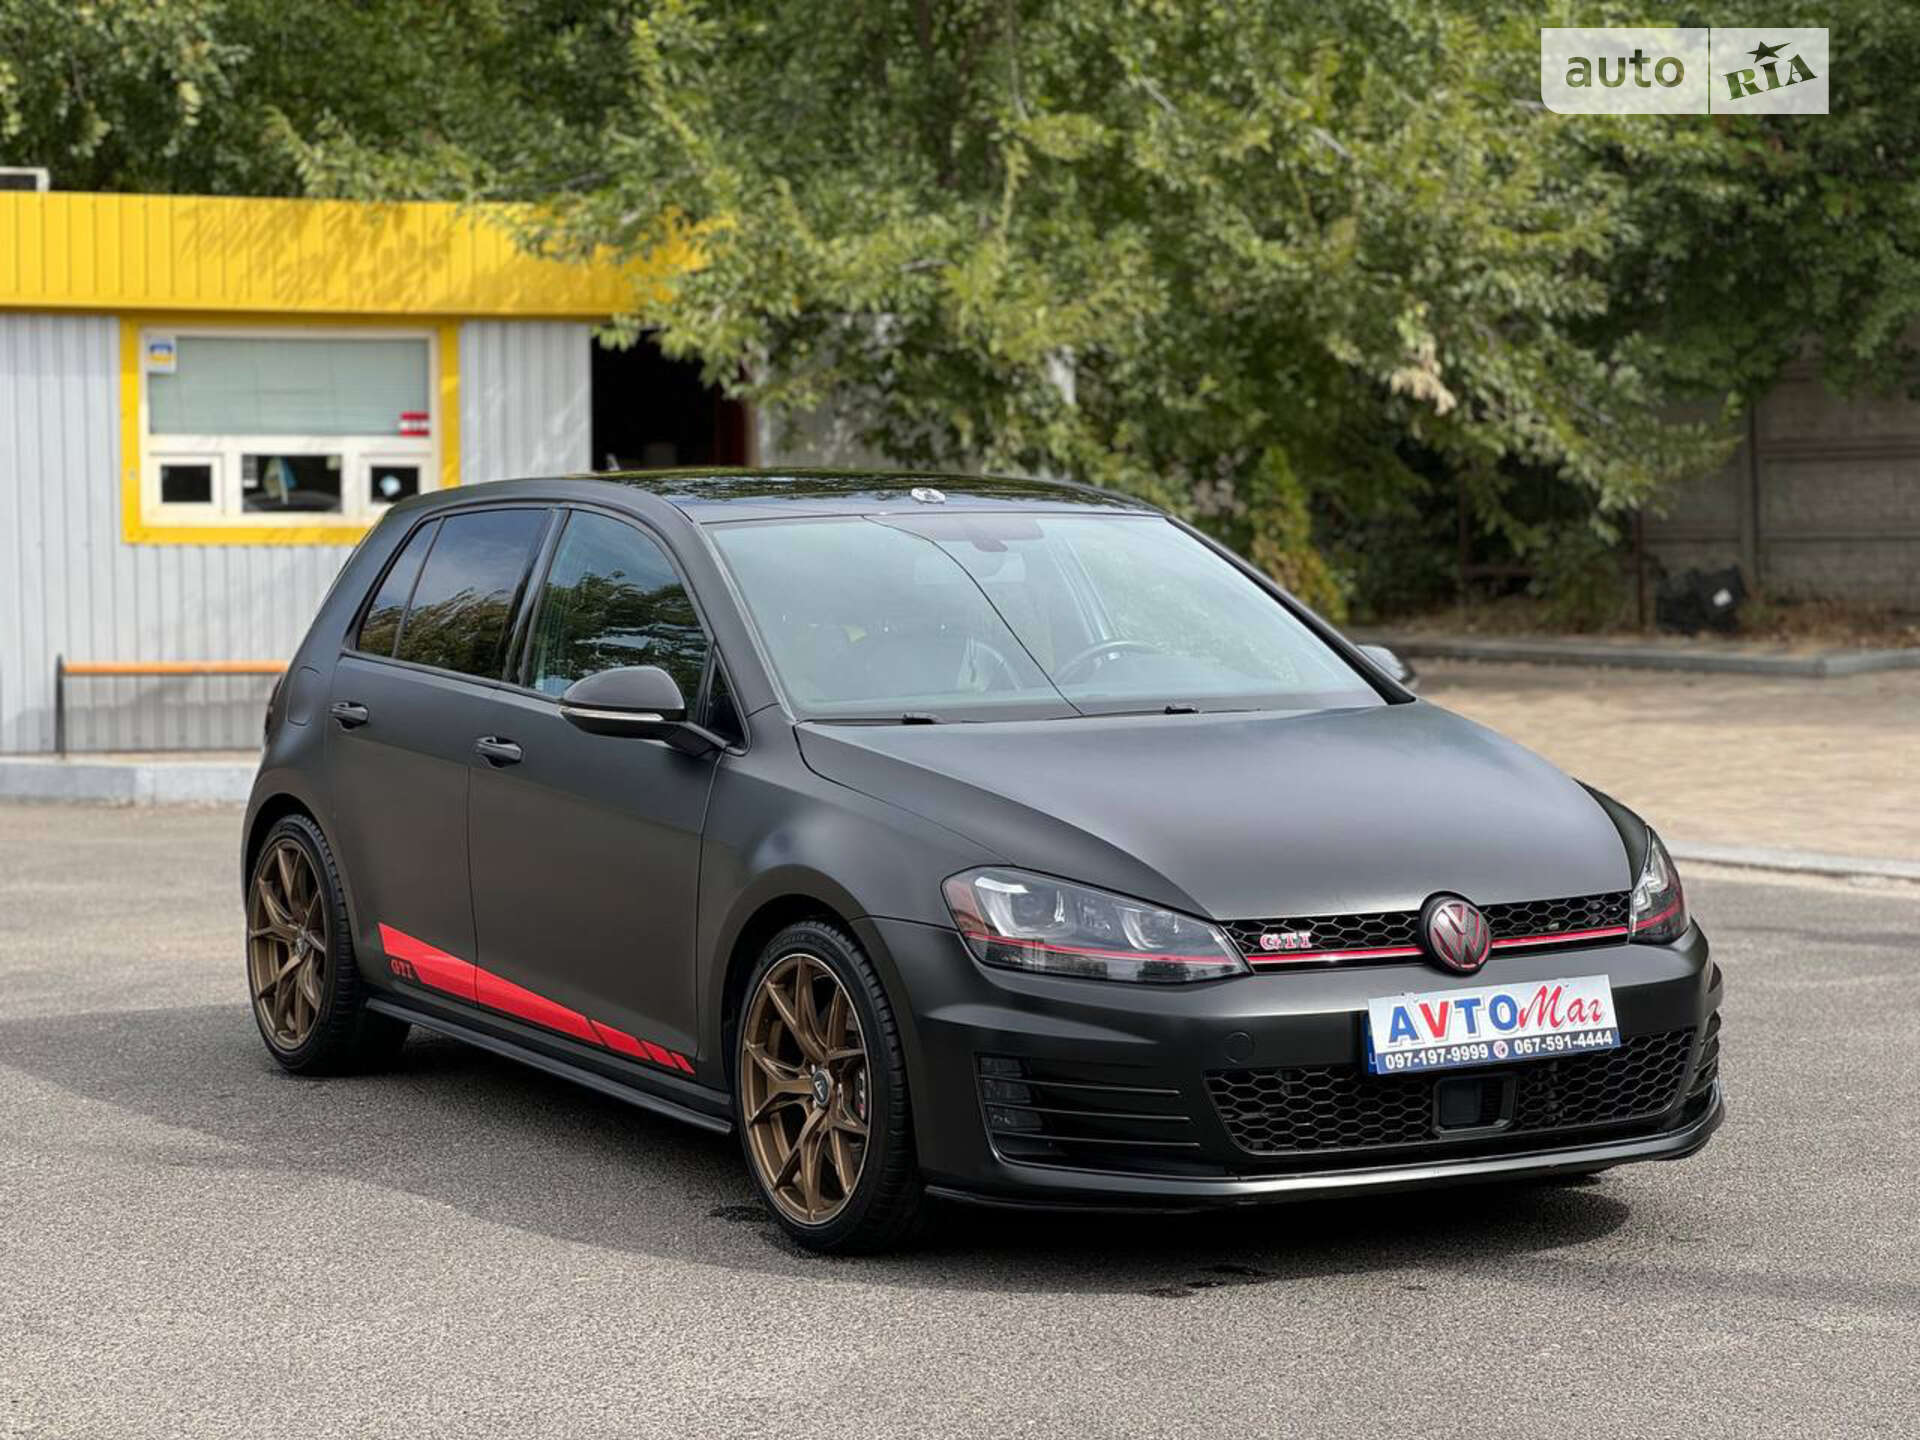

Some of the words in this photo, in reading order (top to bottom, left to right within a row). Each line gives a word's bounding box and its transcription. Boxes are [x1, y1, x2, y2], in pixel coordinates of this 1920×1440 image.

[1260, 933, 1312, 950] GTI
[390, 960, 414, 979] GTI
[1385, 1044, 1489, 1070] 097-197-9999
[1514, 1031, 1613, 1055] 067-591-4444
